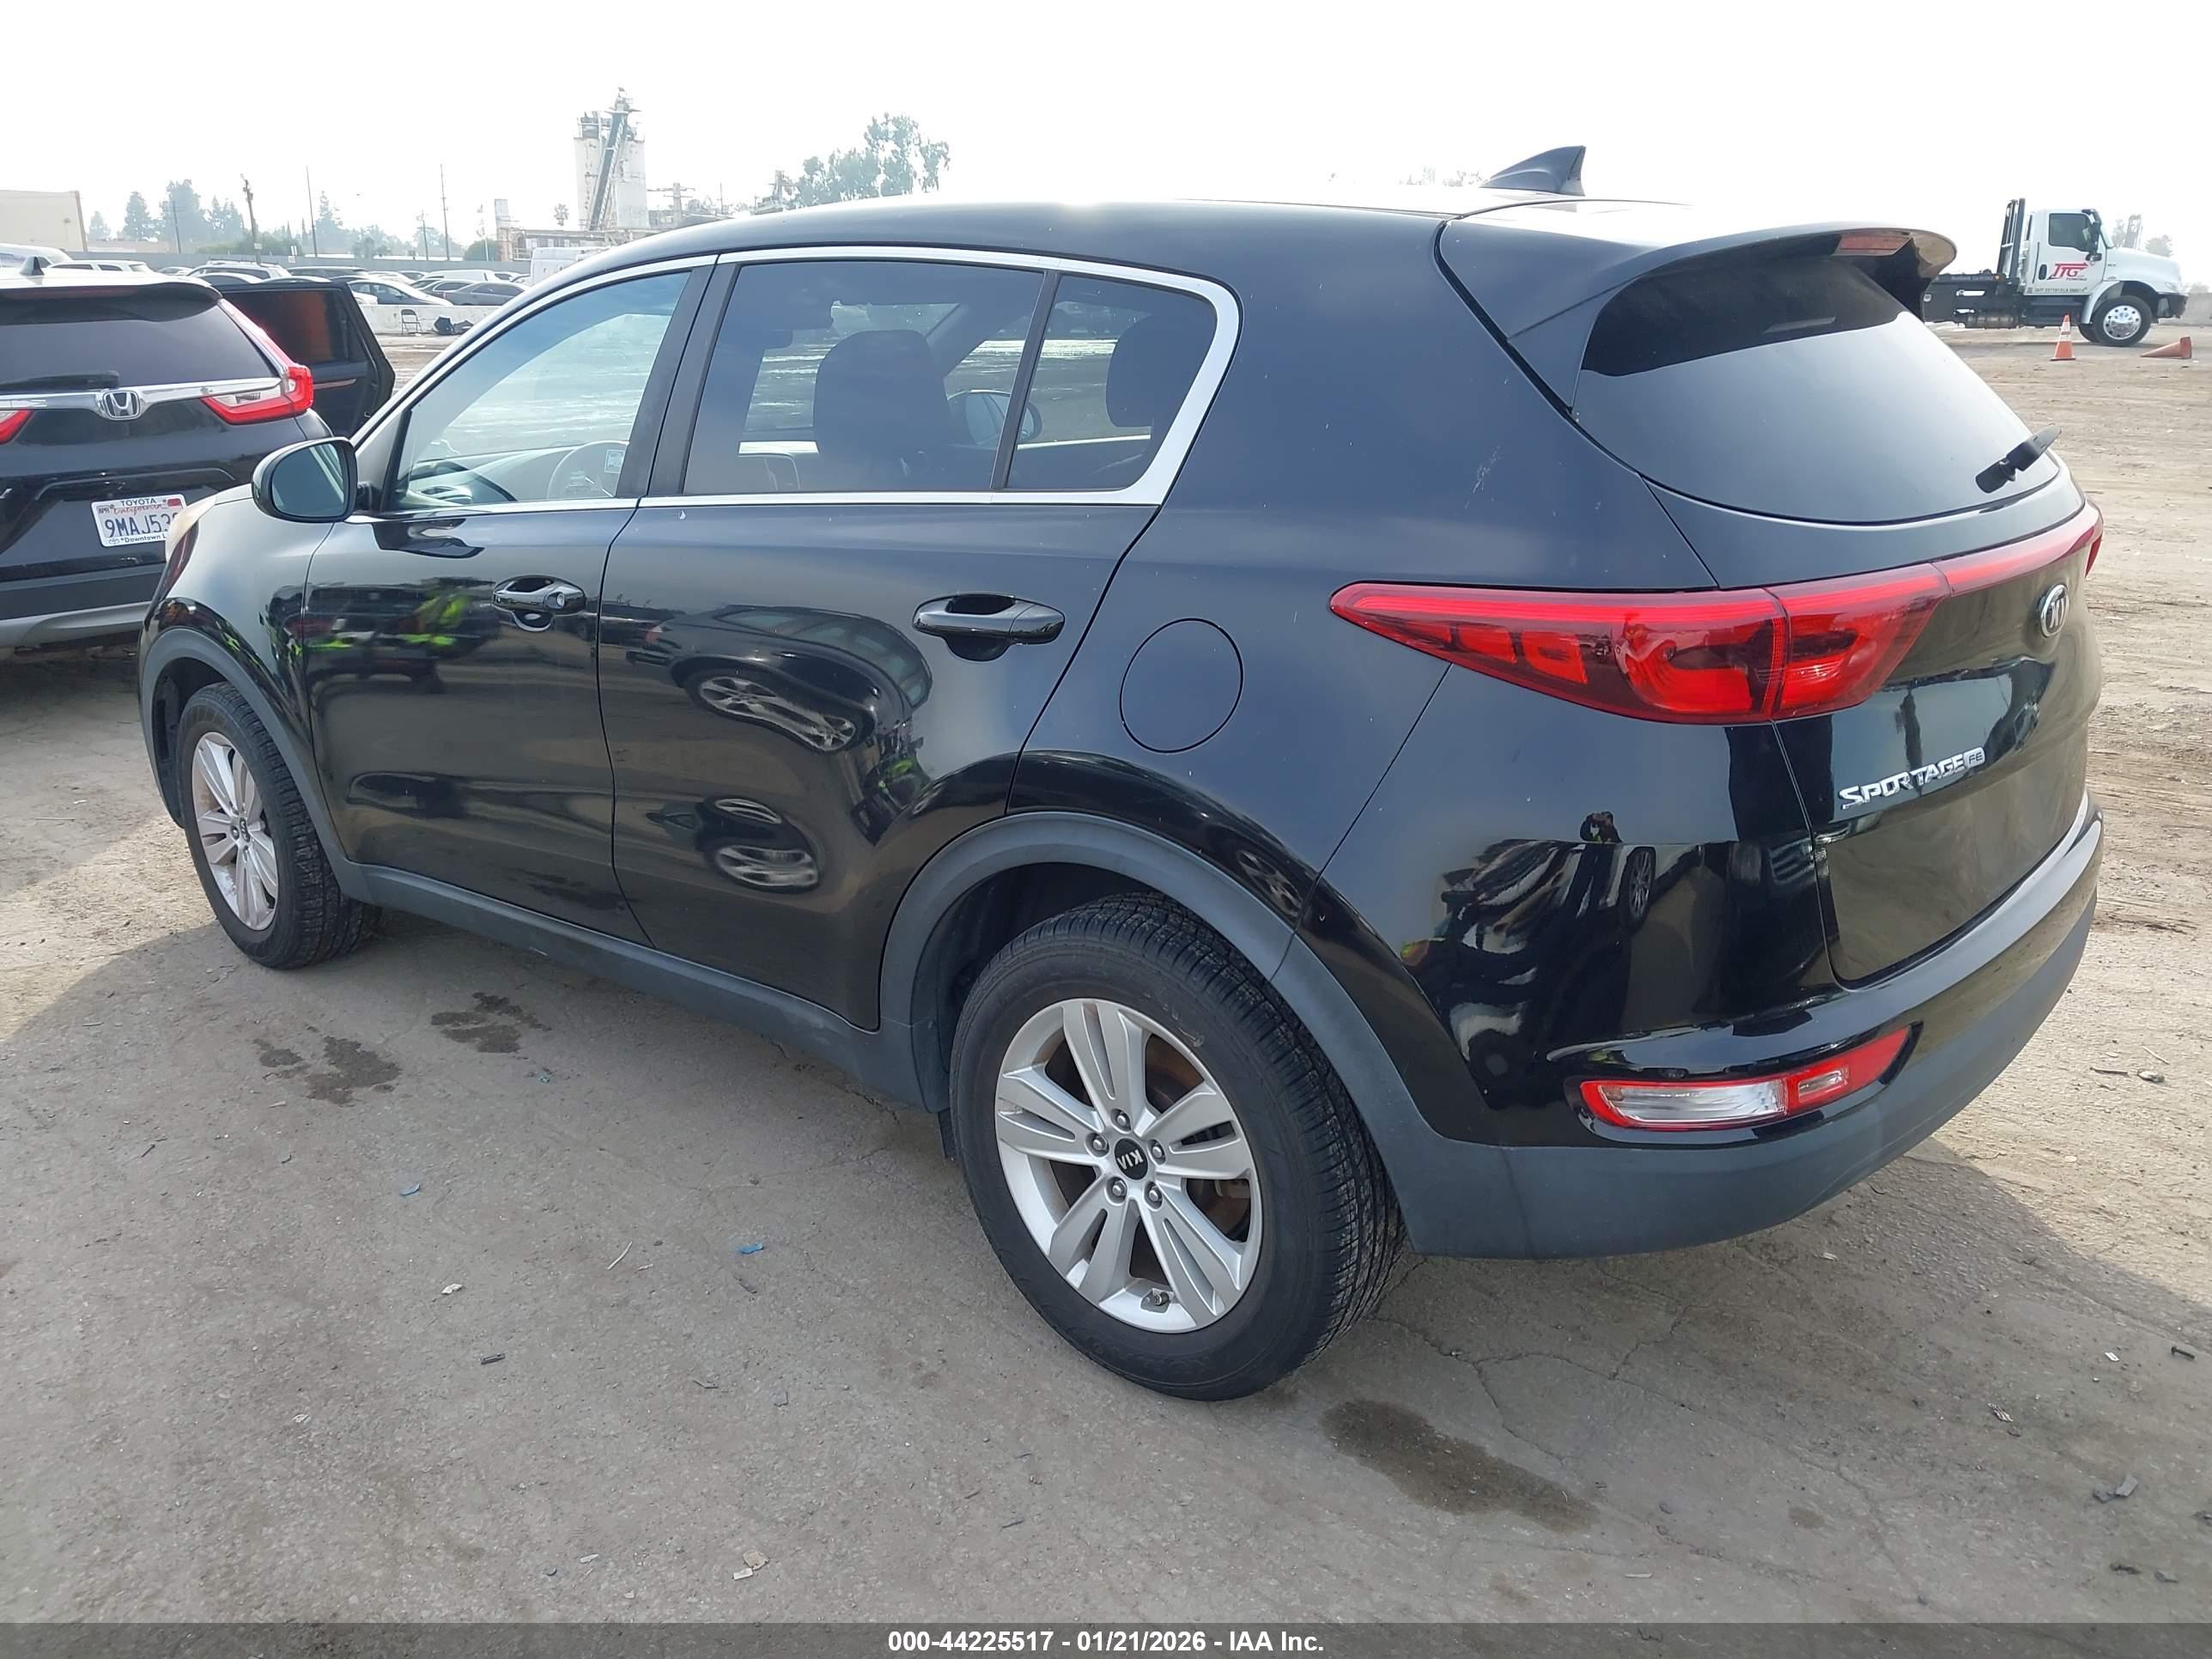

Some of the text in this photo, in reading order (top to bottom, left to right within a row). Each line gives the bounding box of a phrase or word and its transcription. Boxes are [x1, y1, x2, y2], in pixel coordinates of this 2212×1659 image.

[121, 497, 157, 507] TOYOTA
[104, 512, 179, 538] 9MAJ53
[1838, 753, 1966, 811] SPORTAGE
[1116, 1148, 1144, 1170] KIA
